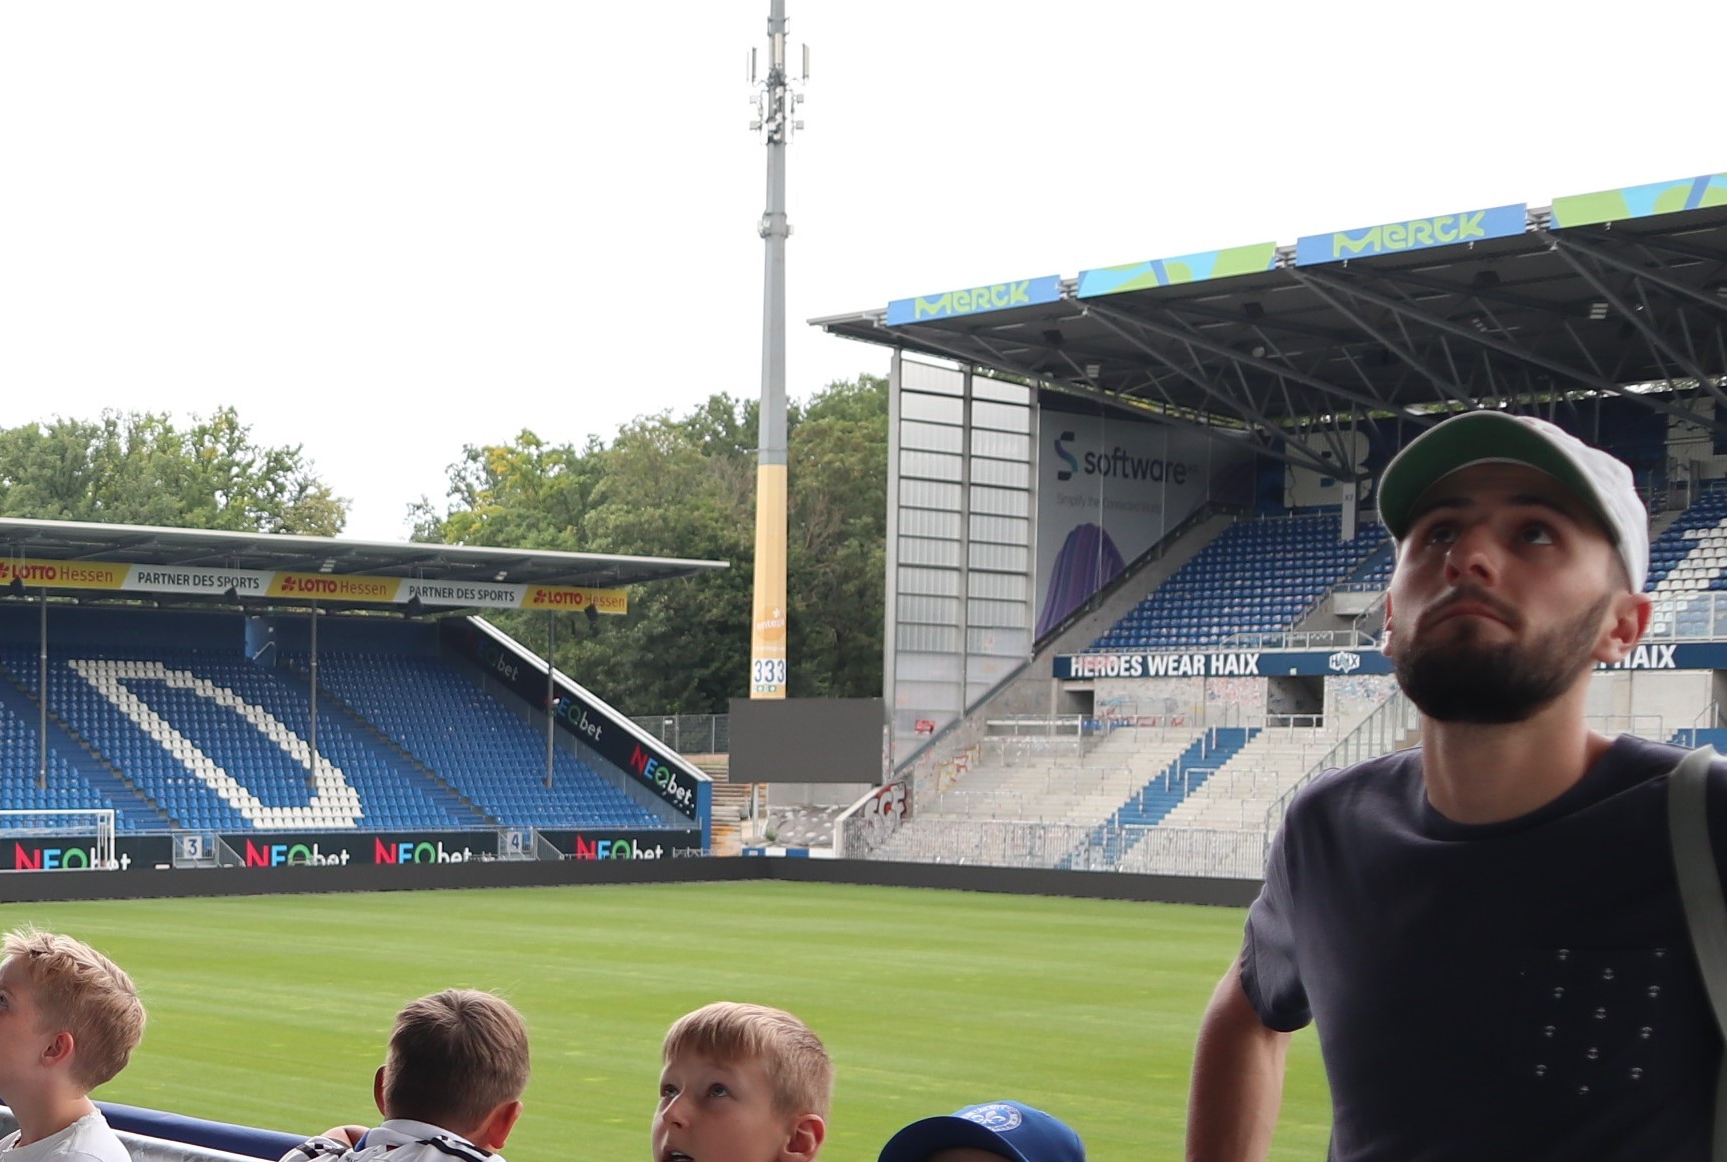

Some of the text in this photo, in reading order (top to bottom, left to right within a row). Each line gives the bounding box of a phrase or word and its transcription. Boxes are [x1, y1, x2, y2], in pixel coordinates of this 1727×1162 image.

[1084, 446, 1186, 485] software
[13, 564, 113, 582] LOTTO Hessen
[137, 572, 260, 589] PARTNER DES SPORTS
[298, 578, 387, 596] LOTTO Hessen
[409, 585, 515, 602] PARTNER DES SPORTS
[548, 591, 625, 609] LOTTO Hessen
[1071, 653, 1260, 677] HEROES WEAR HAIX
[188, 838, 199, 855] 3
[511, 834, 520, 849] 4
